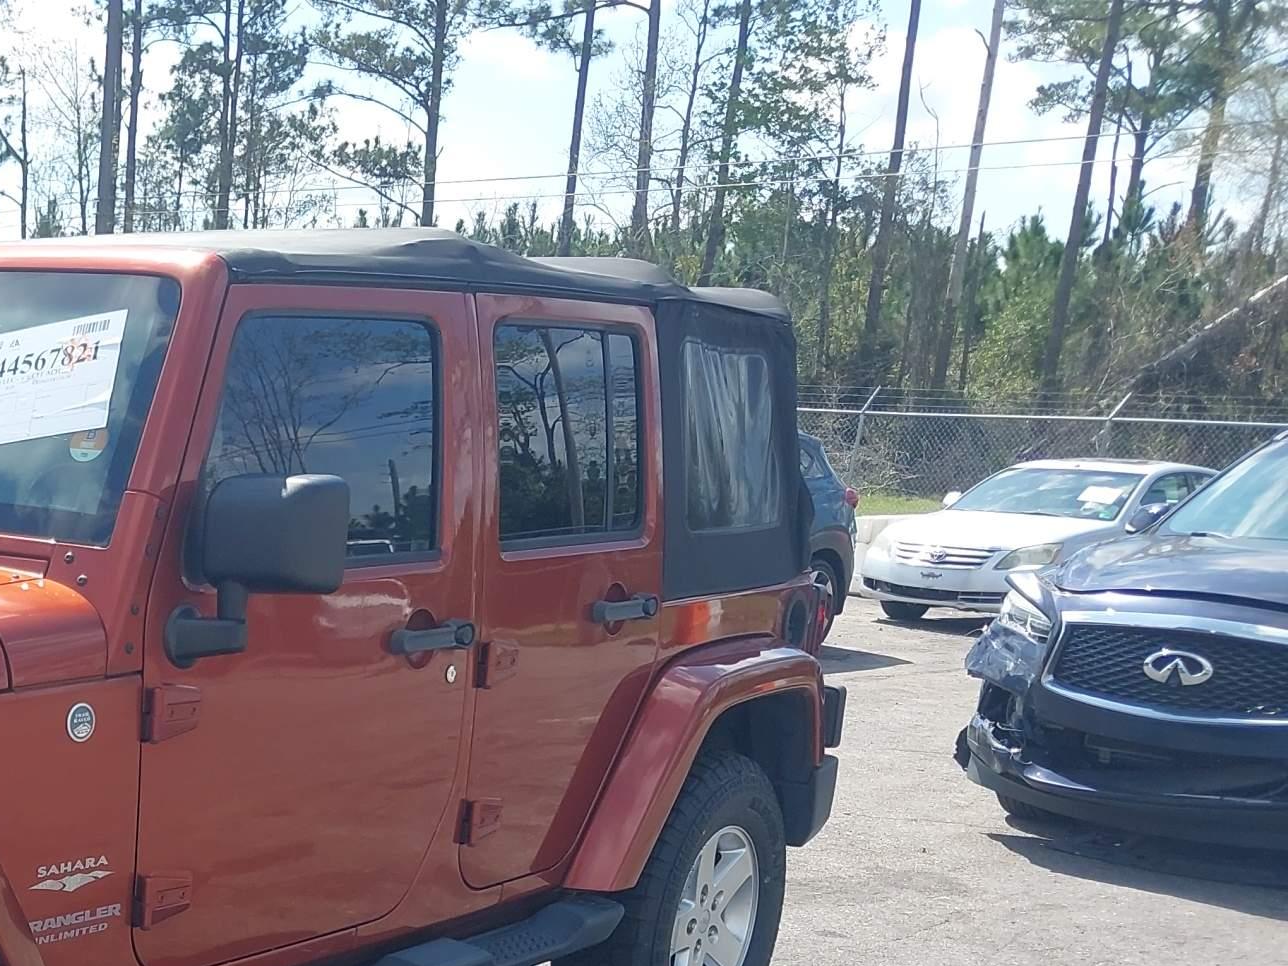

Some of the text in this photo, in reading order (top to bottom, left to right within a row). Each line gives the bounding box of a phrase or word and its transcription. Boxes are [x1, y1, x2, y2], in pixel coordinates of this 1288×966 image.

[37, 855, 109, 878] SAHARA
[28, 903, 121, 934] RANGLER
[35, 922, 108, 945] NLIMITED
